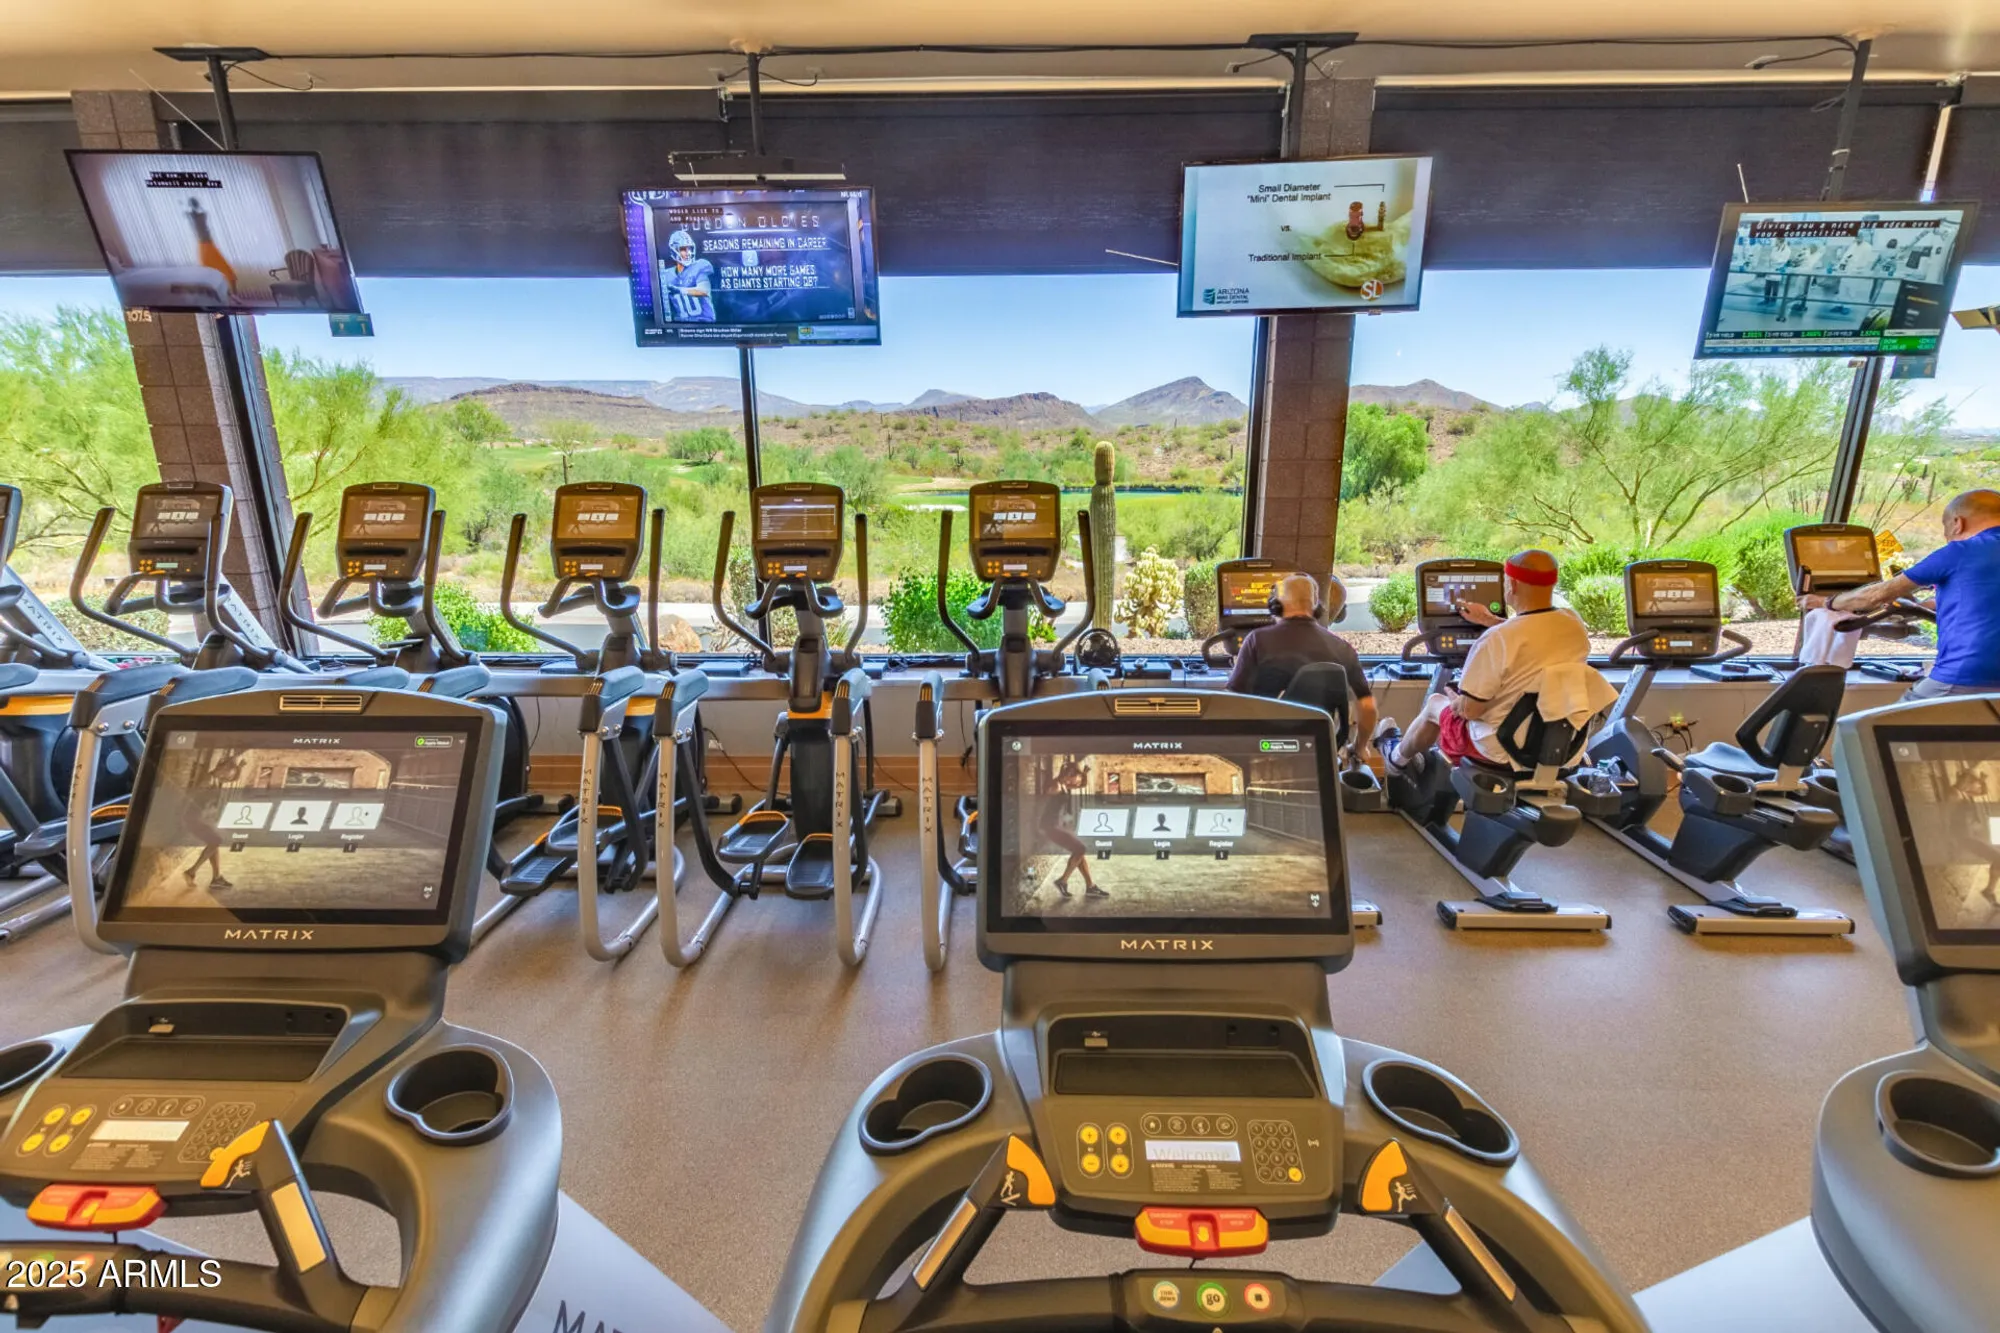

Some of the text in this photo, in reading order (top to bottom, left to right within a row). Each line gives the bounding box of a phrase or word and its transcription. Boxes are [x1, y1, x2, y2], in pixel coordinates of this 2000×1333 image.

[1258, 182, 1321, 193] Small Diameter
[1272, 193, 1300, 203] Dental
[1301, 192, 1331, 203] Implant
[1281, 225, 1292, 233] vs.
[1756, 222, 1791, 230] Giving
[1796, 222, 1814, 230] you
[1860, 221, 1877, 229] big
[1883, 221, 1905, 229] edge
[703, 237, 827, 251] SEASONS REMAINING IN CAREER
[1248, 252, 1322, 263] Traditional Implant
[720, 265, 815, 277] HOW MANY MORE GAMES
[720, 278, 732, 289] AS
[733, 277, 761, 289] GIANTS
[764, 277, 801, 288] STARTING
[922, 777, 932, 833] MATRIX
[288, 833, 304, 841] Login
[1153, 840, 1171, 848] Login
[1209, 840, 1234, 848] Register
[223, 928, 315, 941] MATRIX
[1120, 939, 1214, 951] MATRIX
[1205, 1293, 1220, 1306] go
